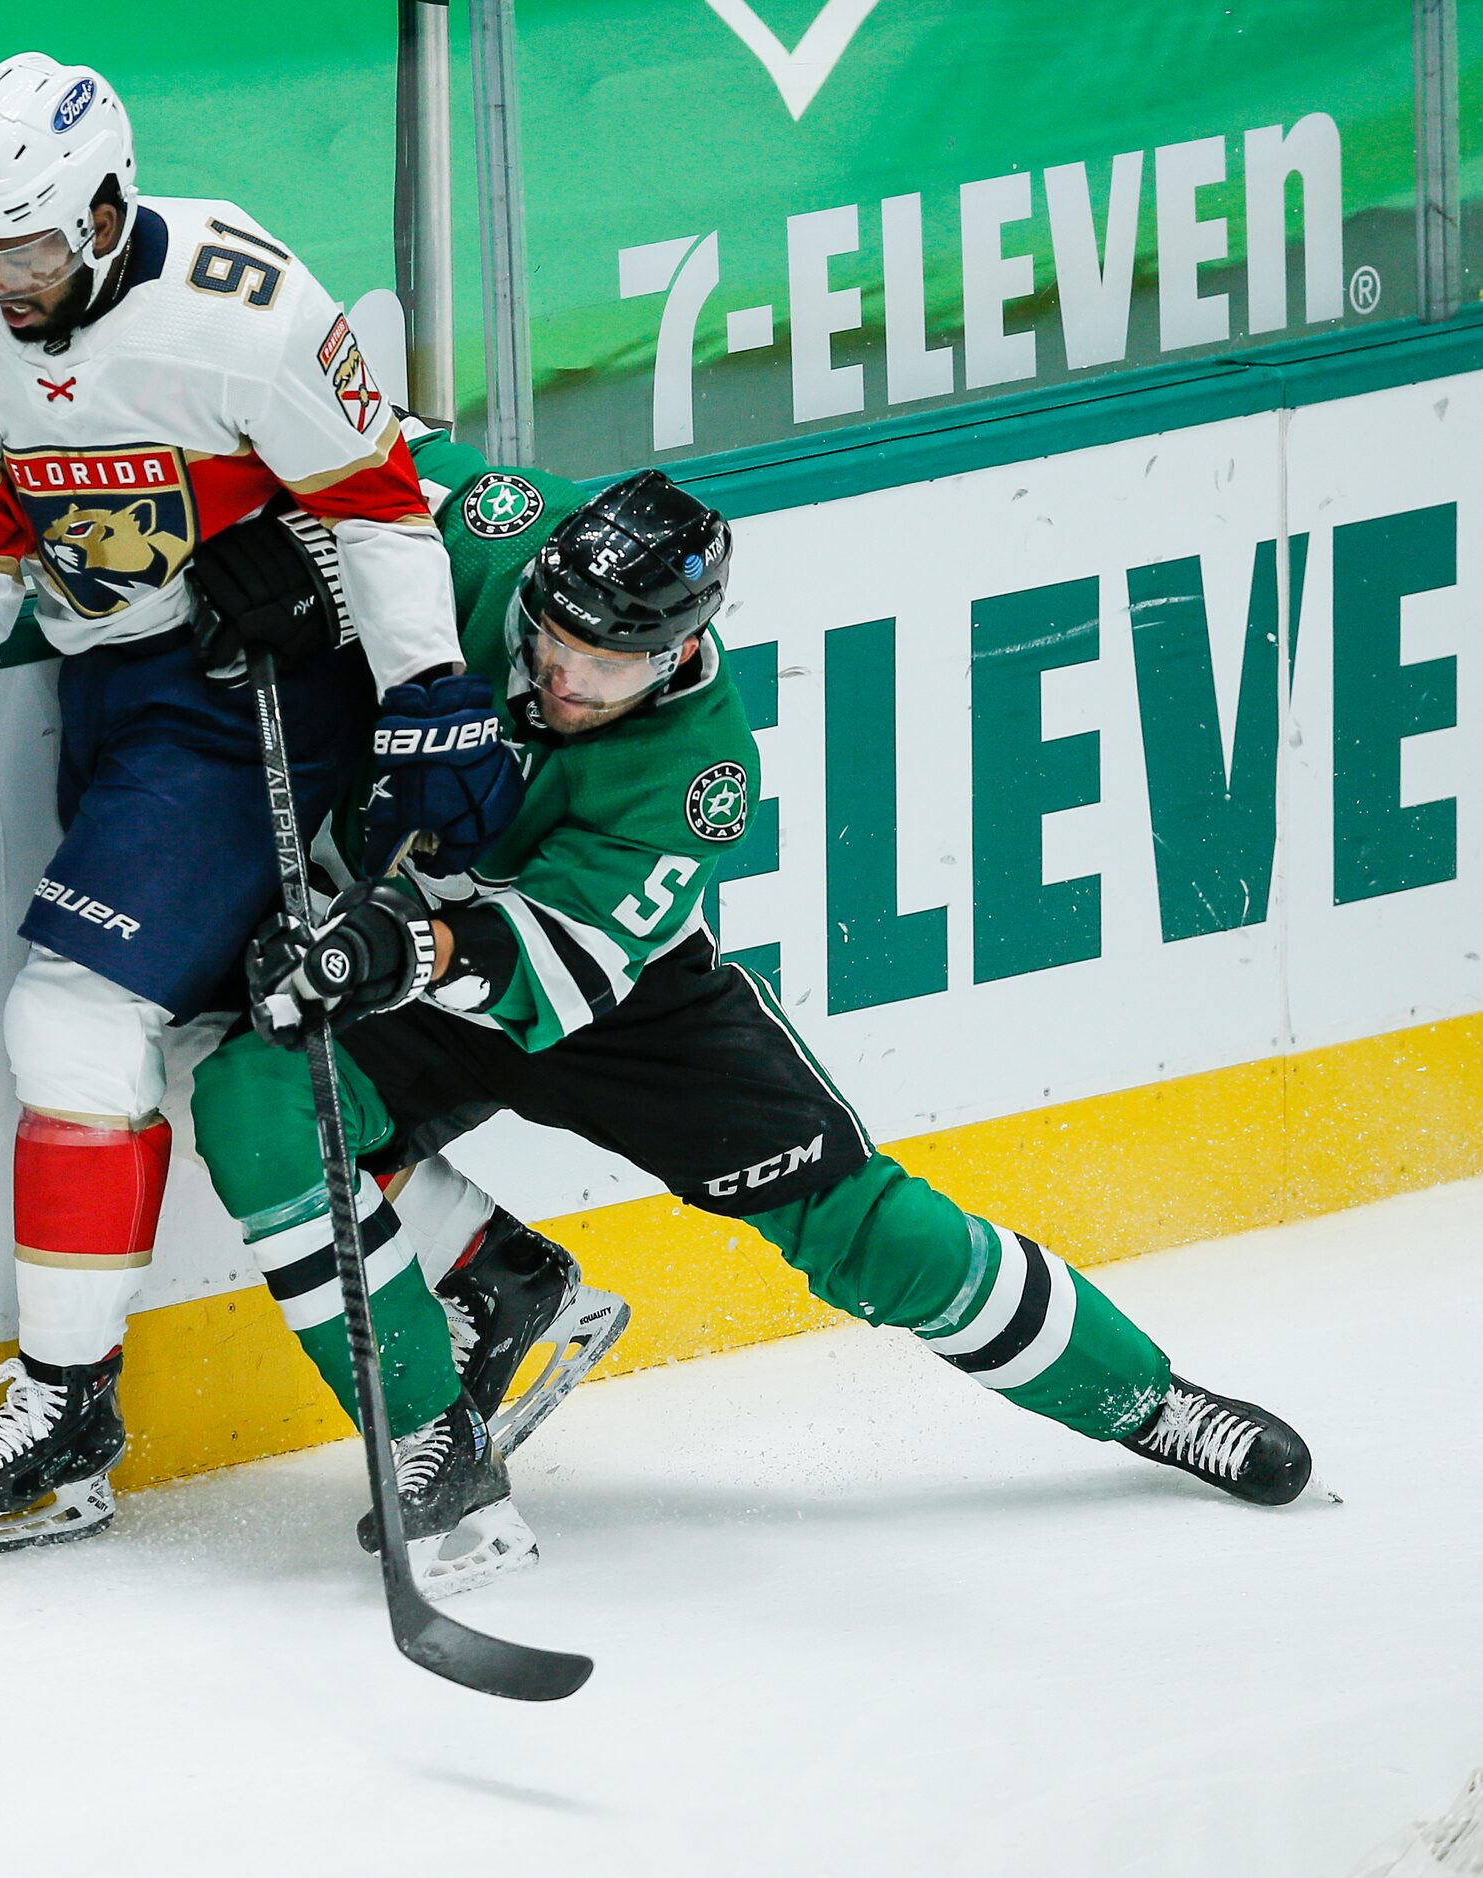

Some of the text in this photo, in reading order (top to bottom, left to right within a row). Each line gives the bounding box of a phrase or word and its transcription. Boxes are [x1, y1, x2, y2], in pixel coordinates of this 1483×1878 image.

[59, 81, 92, 125] Ford
[185, 216, 292, 312] 91
[588, 548, 619, 578] 5
[552, 590, 603, 626] CCM
[266, 766, 299, 877] ALPHA
[612, 854, 701, 938] 5
[702, 1133, 824, 1197] CCM
[579, 1306, 612, 1325] EQUALITY
